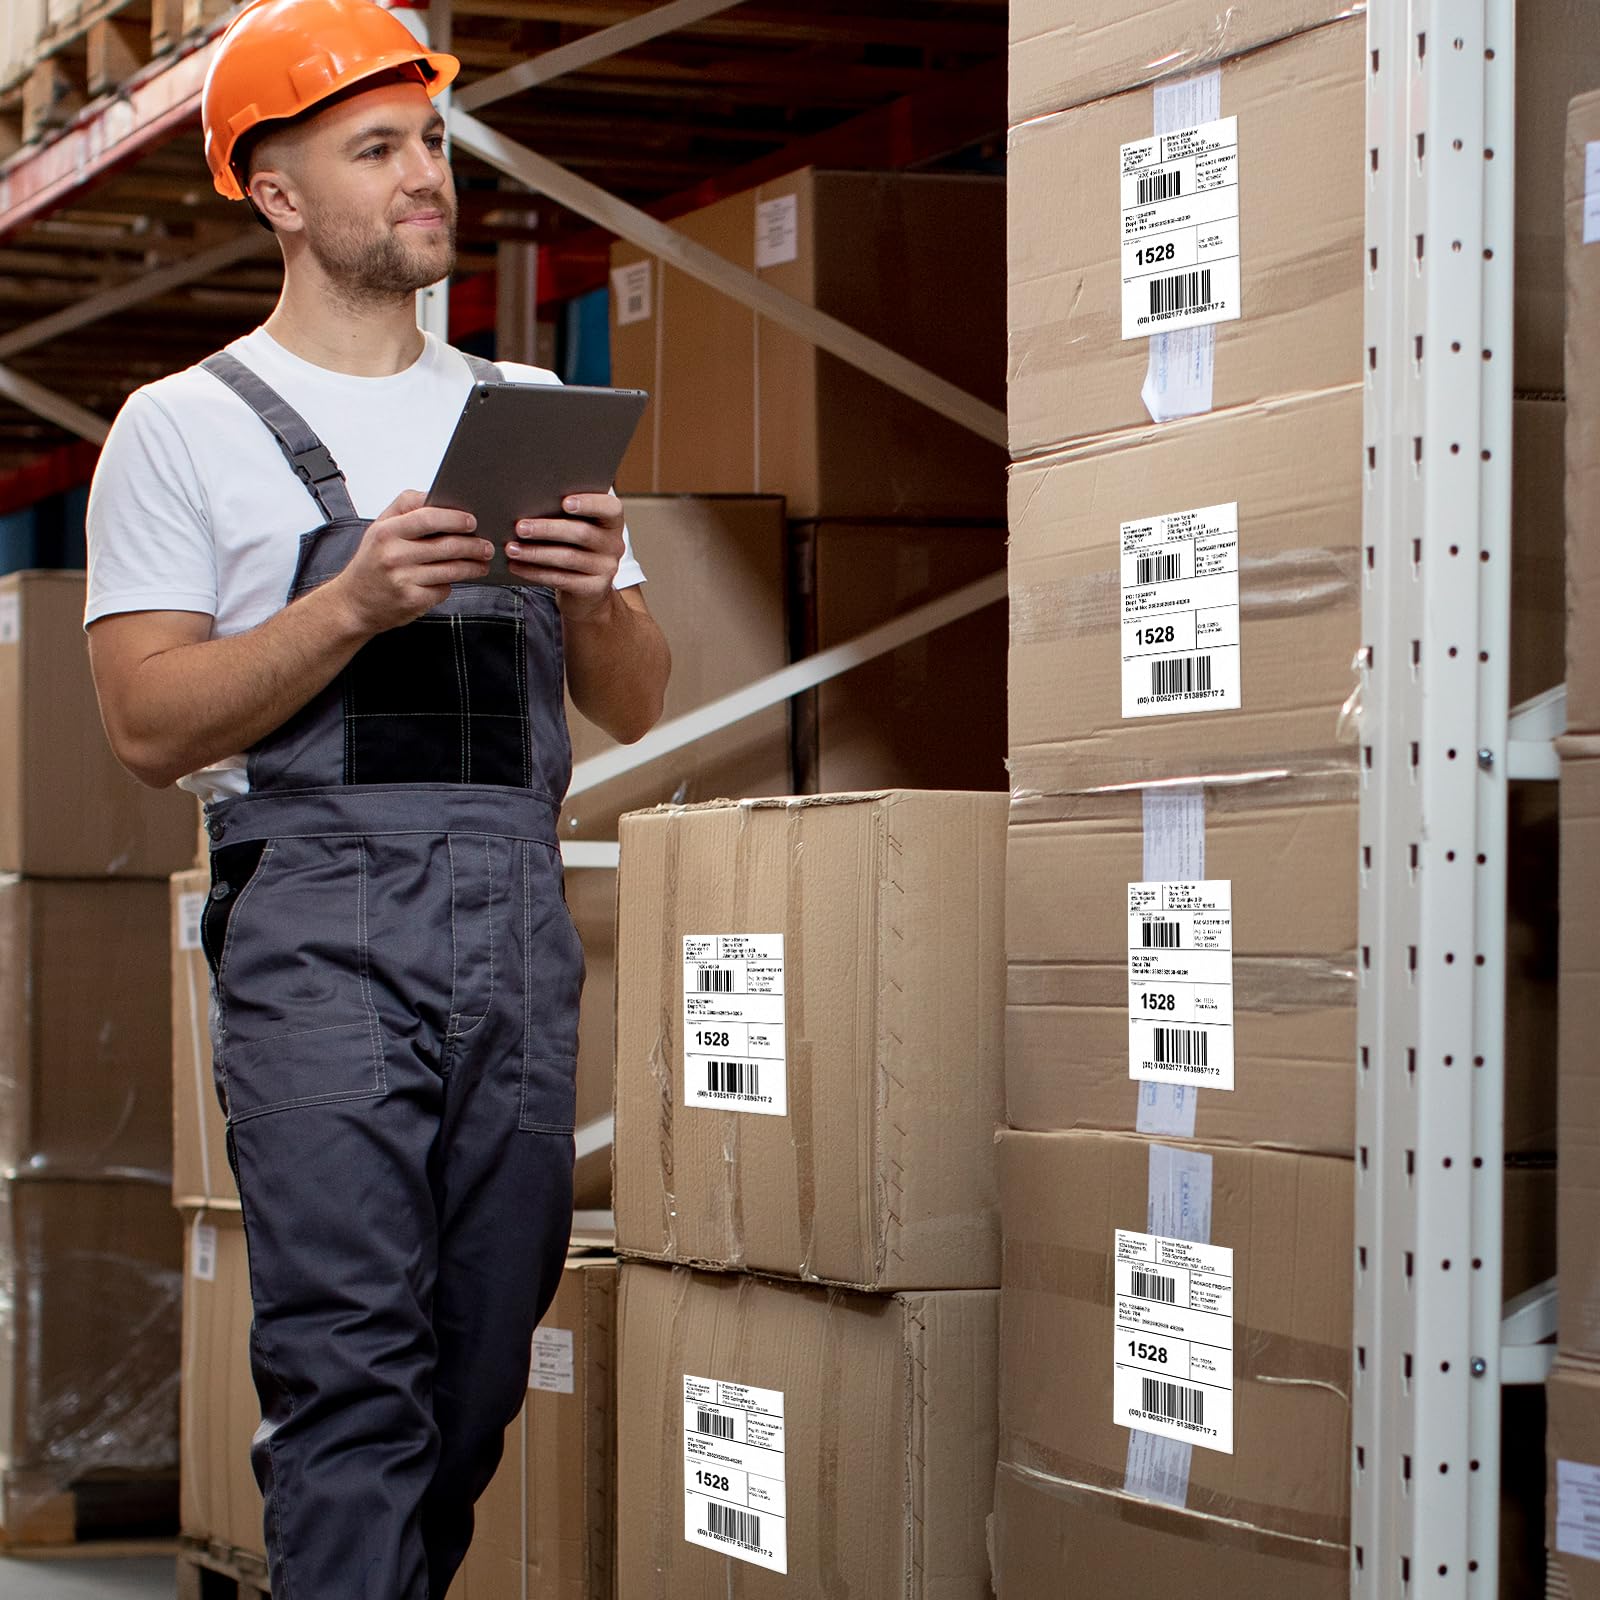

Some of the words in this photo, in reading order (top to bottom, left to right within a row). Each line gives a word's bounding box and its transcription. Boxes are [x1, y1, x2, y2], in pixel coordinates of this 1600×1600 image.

[1136, 243, 1174, 265] 1528
[1136, 626, 1174, 645] 1528
[1141, 993, 1175, 1011] 1528
[696, 1031, 729, 1047] 1528
[1128, 1341, 1167, 1363] 1528
[1129, 1409, 1141, 1418] (00)
[696, 1470, 729, 1491] 1528
